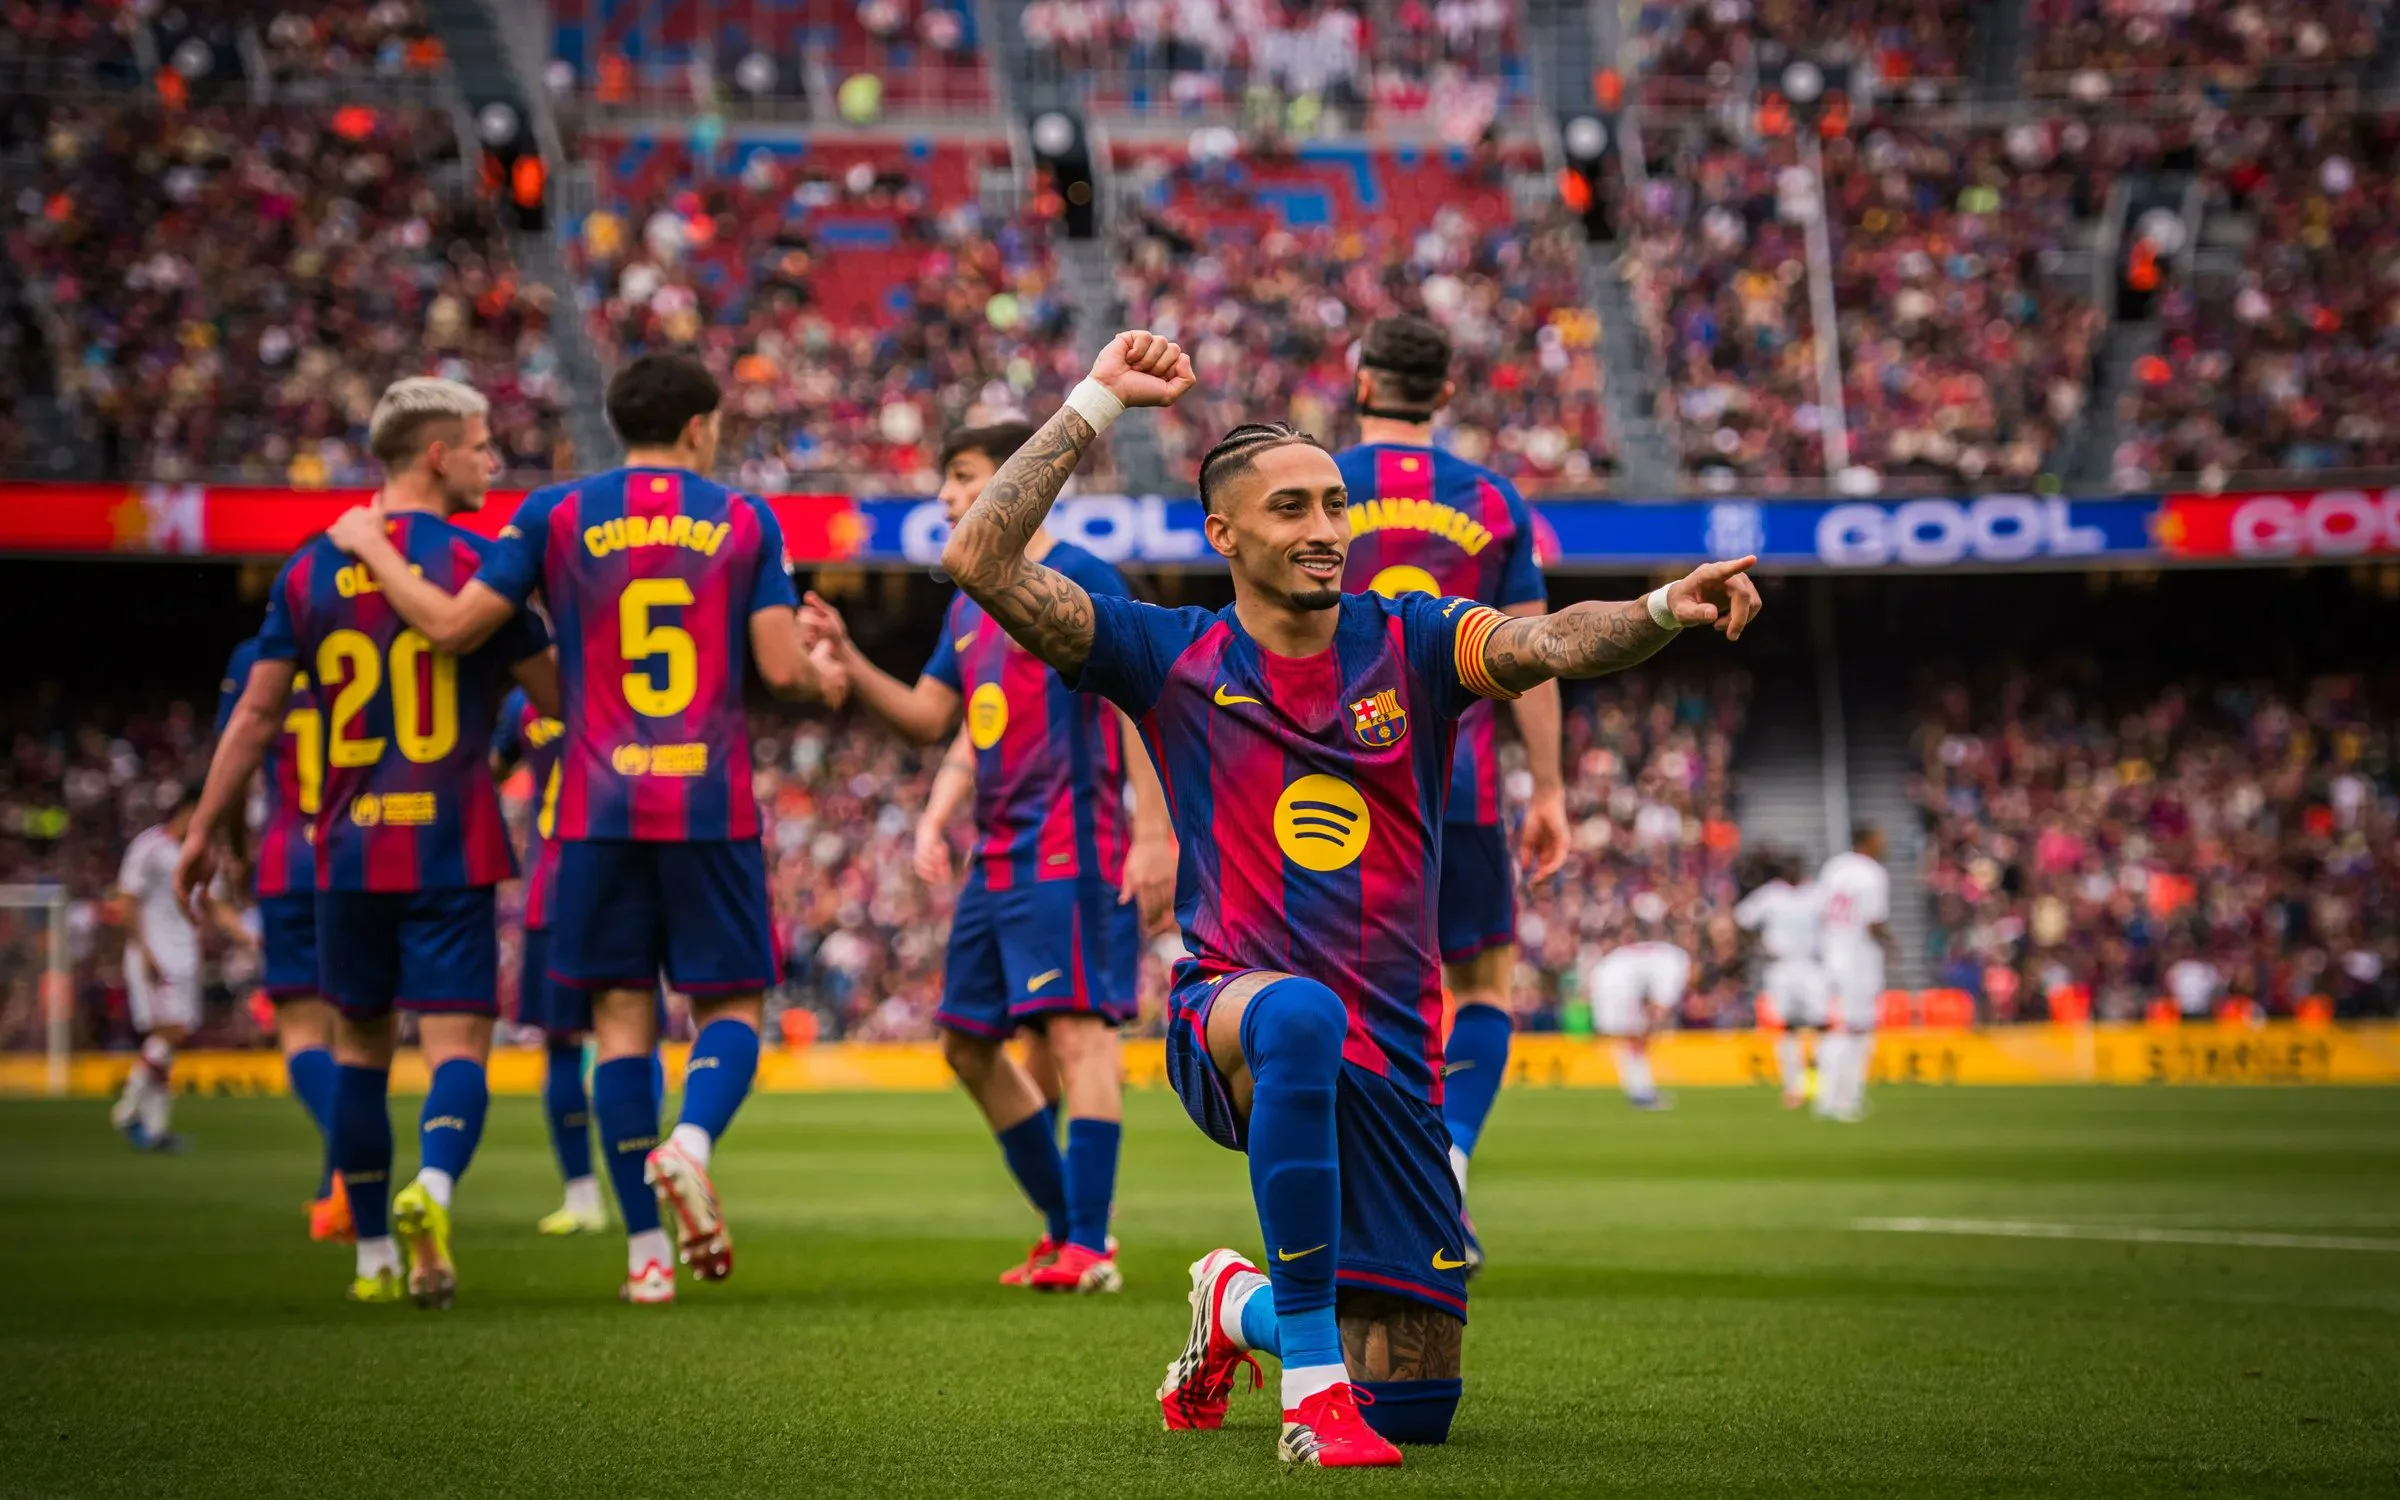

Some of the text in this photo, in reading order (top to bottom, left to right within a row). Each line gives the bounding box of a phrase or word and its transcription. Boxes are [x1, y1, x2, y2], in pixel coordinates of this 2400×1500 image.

[1347, 497, 1493, 557] WANDOWSKI
[316, 628, 458, 768] 20
[619, 578, 698, 718] 5
[283, 707, 323, 815] 1
